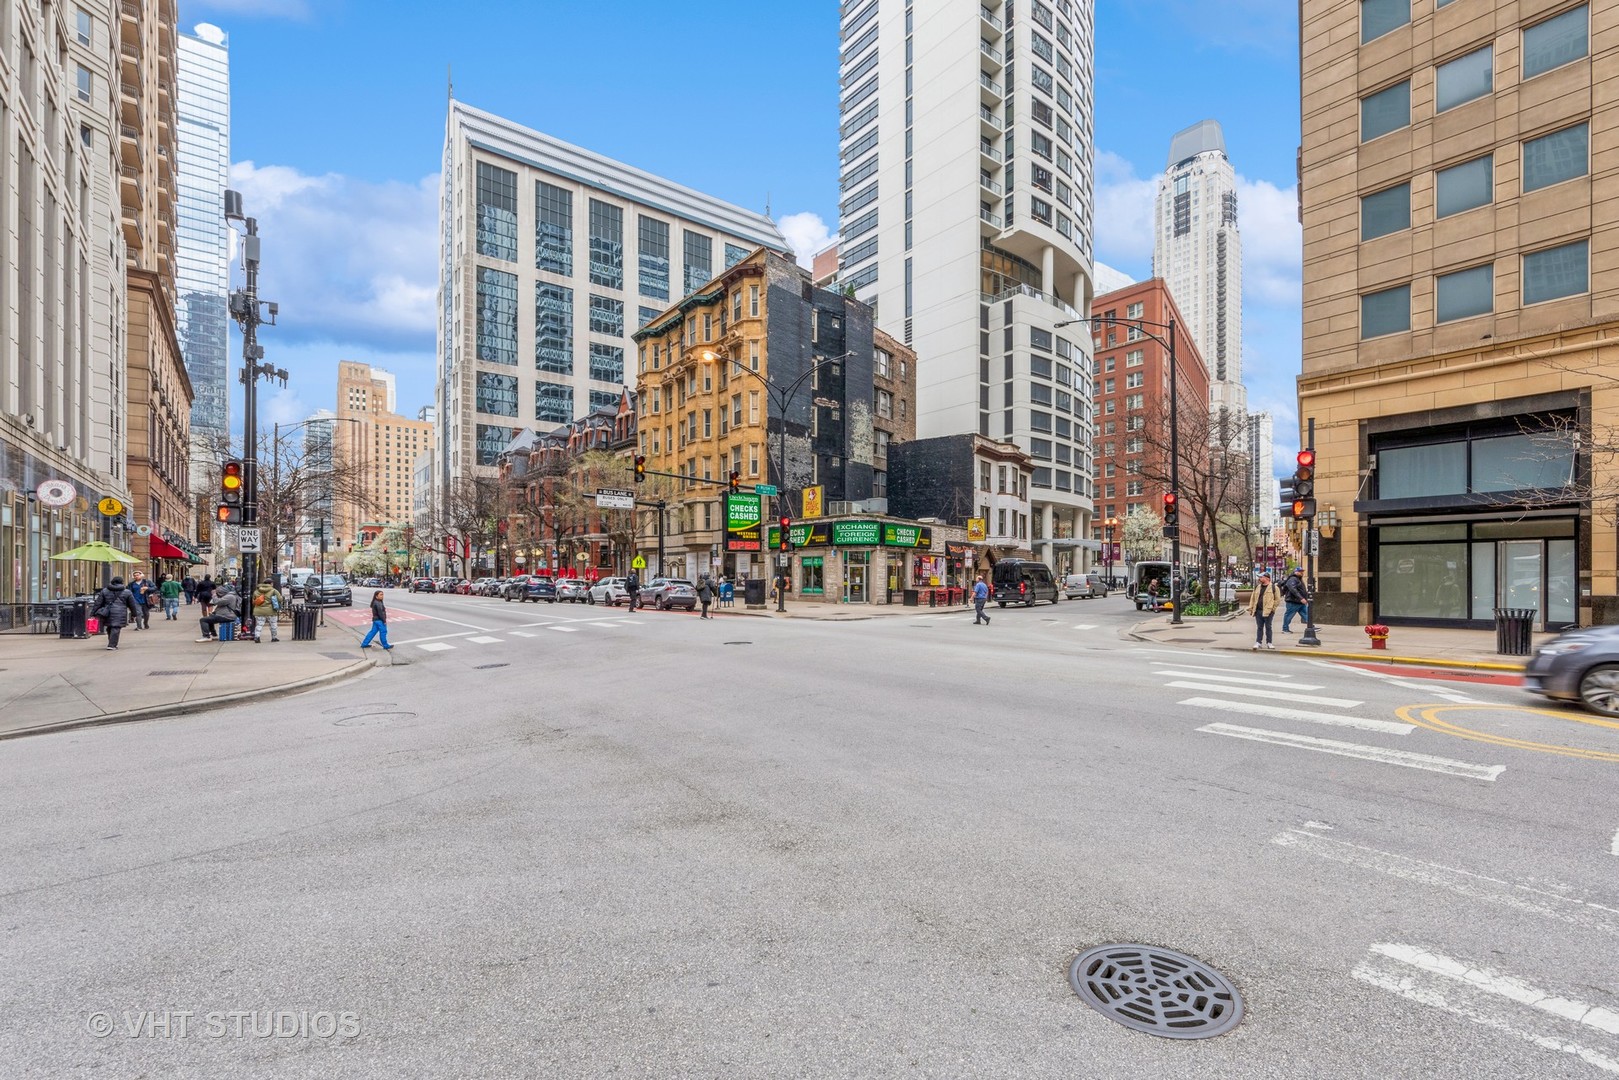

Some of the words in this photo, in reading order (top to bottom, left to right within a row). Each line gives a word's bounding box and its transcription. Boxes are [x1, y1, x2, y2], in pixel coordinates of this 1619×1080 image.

[730, 504, 758, 512] CHECKS
[730, 512, 759, 520] CASHED
[896, 528, 915, 537] CHECKS
[729, 541, 759, 550] OPEN
